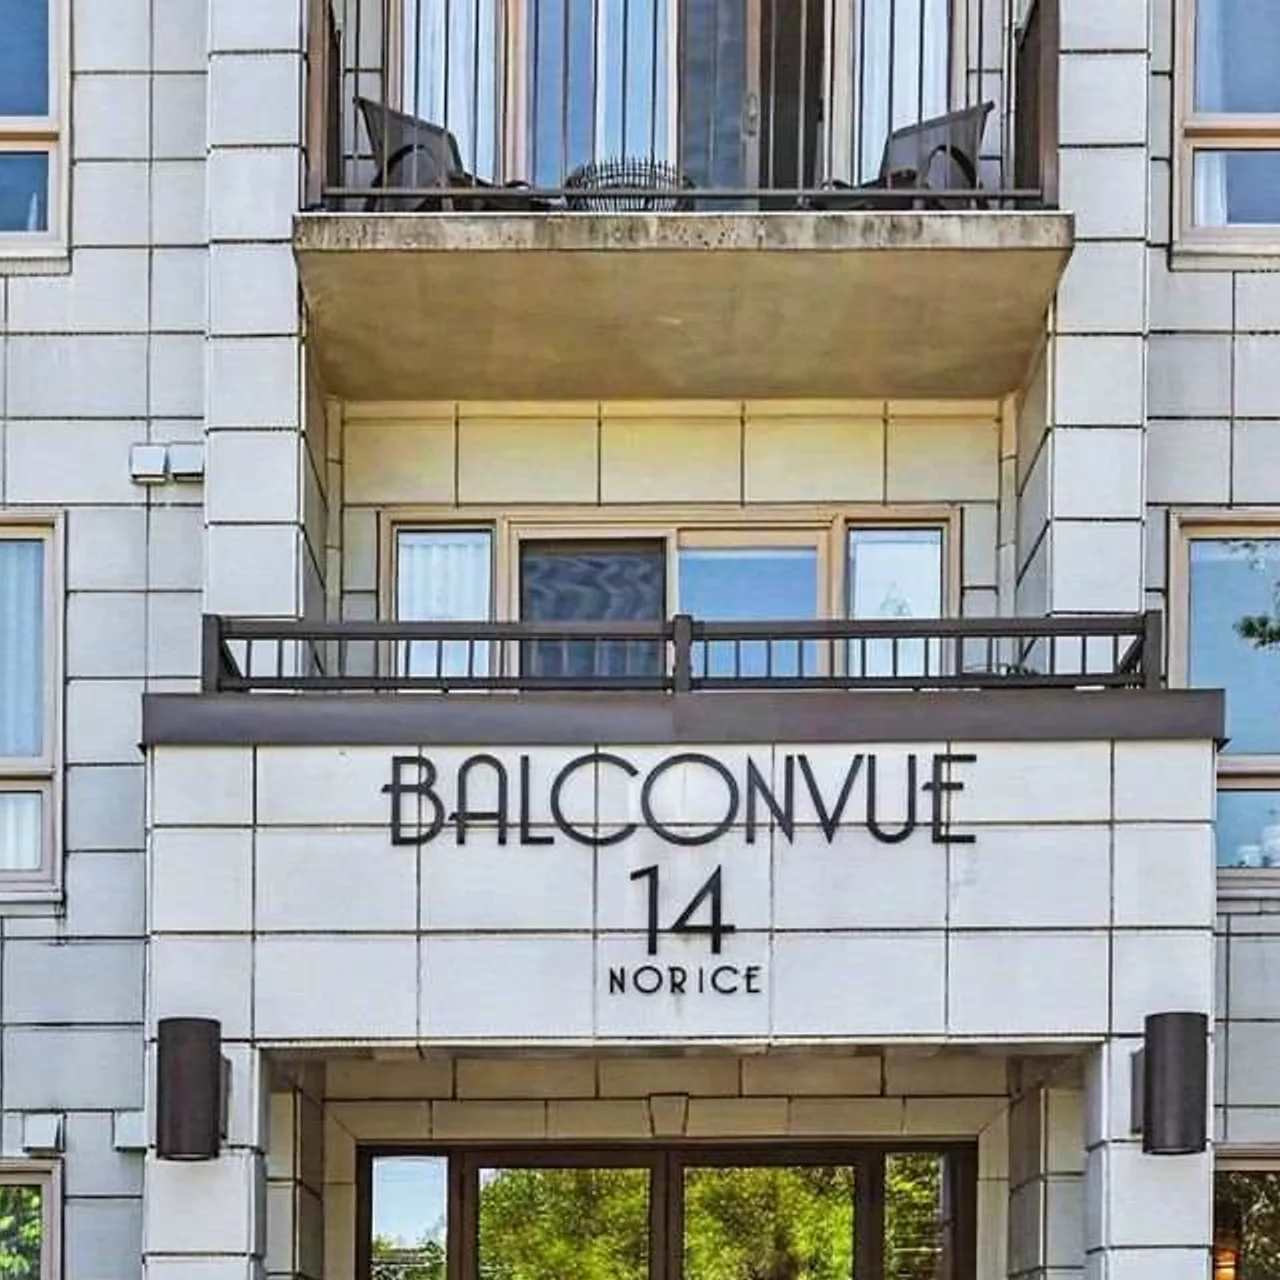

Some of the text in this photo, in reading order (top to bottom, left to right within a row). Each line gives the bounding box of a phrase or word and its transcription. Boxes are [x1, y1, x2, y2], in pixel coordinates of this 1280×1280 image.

[381, 752, 977, 846] BALCONVUE
[630, 864, 738, 956] 14
[608, 965, 762, 995] NORICE
